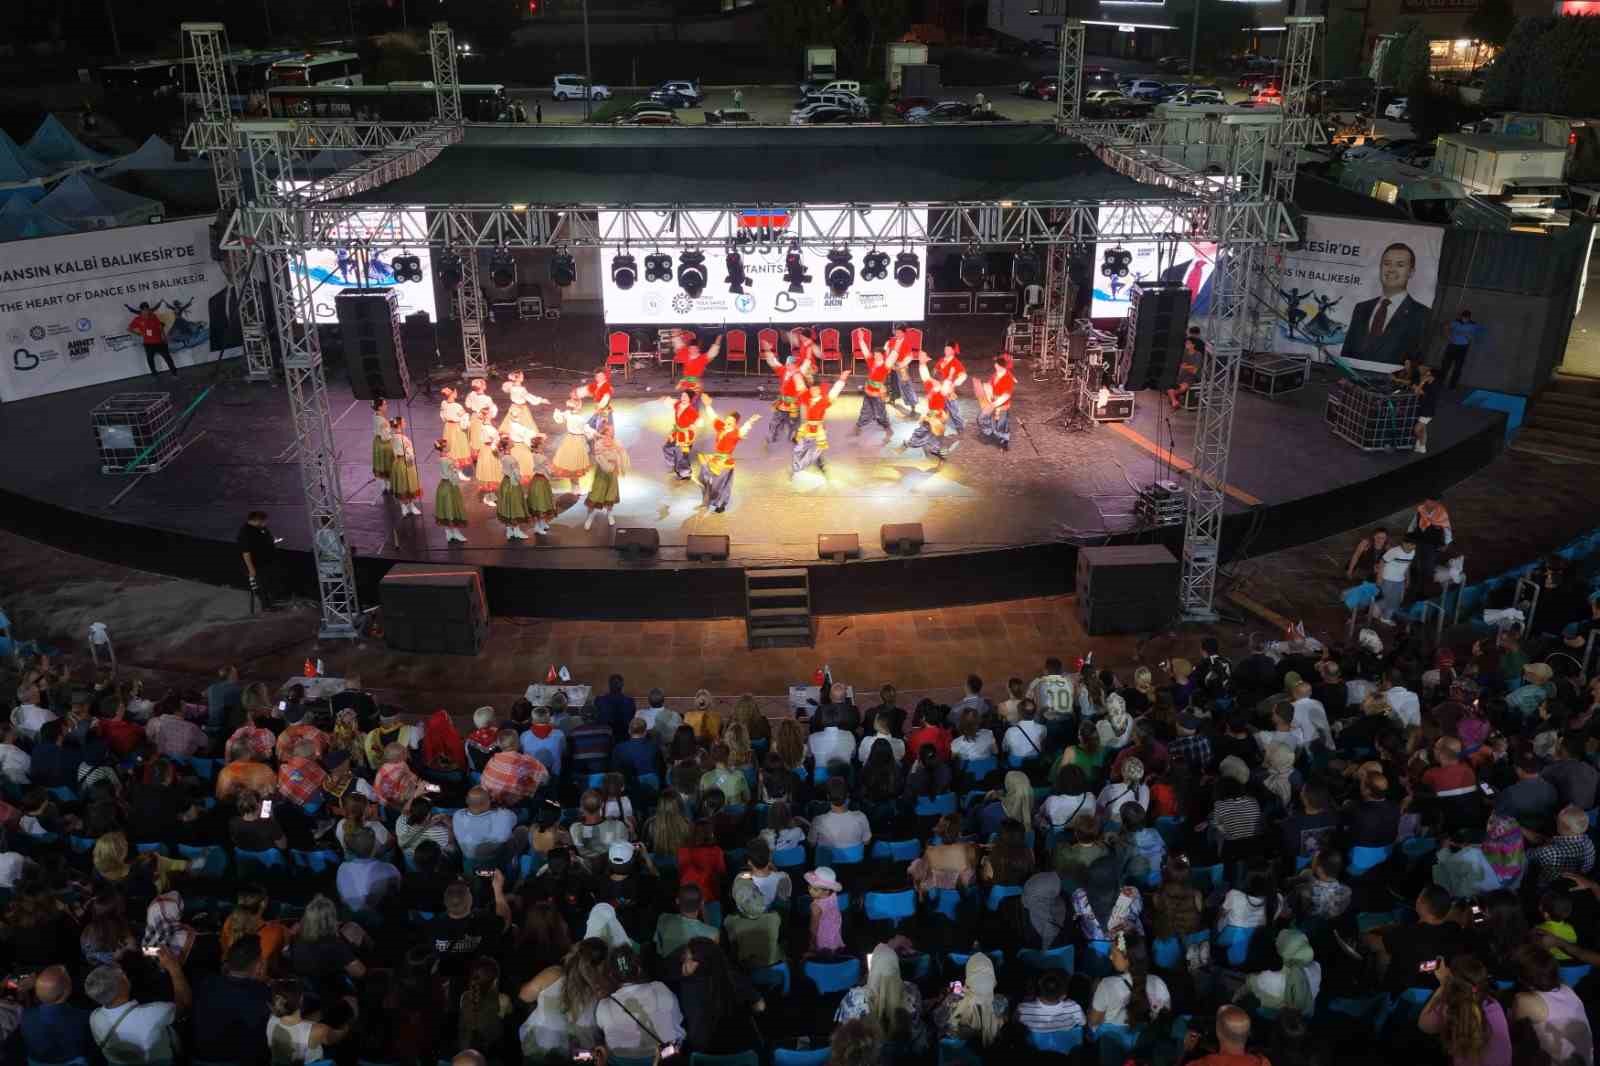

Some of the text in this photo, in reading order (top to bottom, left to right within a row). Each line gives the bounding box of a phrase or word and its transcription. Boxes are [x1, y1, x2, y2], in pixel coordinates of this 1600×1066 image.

[0, 245, 195, 283] ANSIN KALBİ BALIKESİR'DE
[0, 301, 24, 313] THE
[26, 295, 63, 309] HEART
[66, 292, 82, 303] OF
[85, 286, 124, 301] DANCE
[126, 284, 136, 294] IS
[138, 281, 150, 293] IN
[1046, 688, 1070, 711] 10
